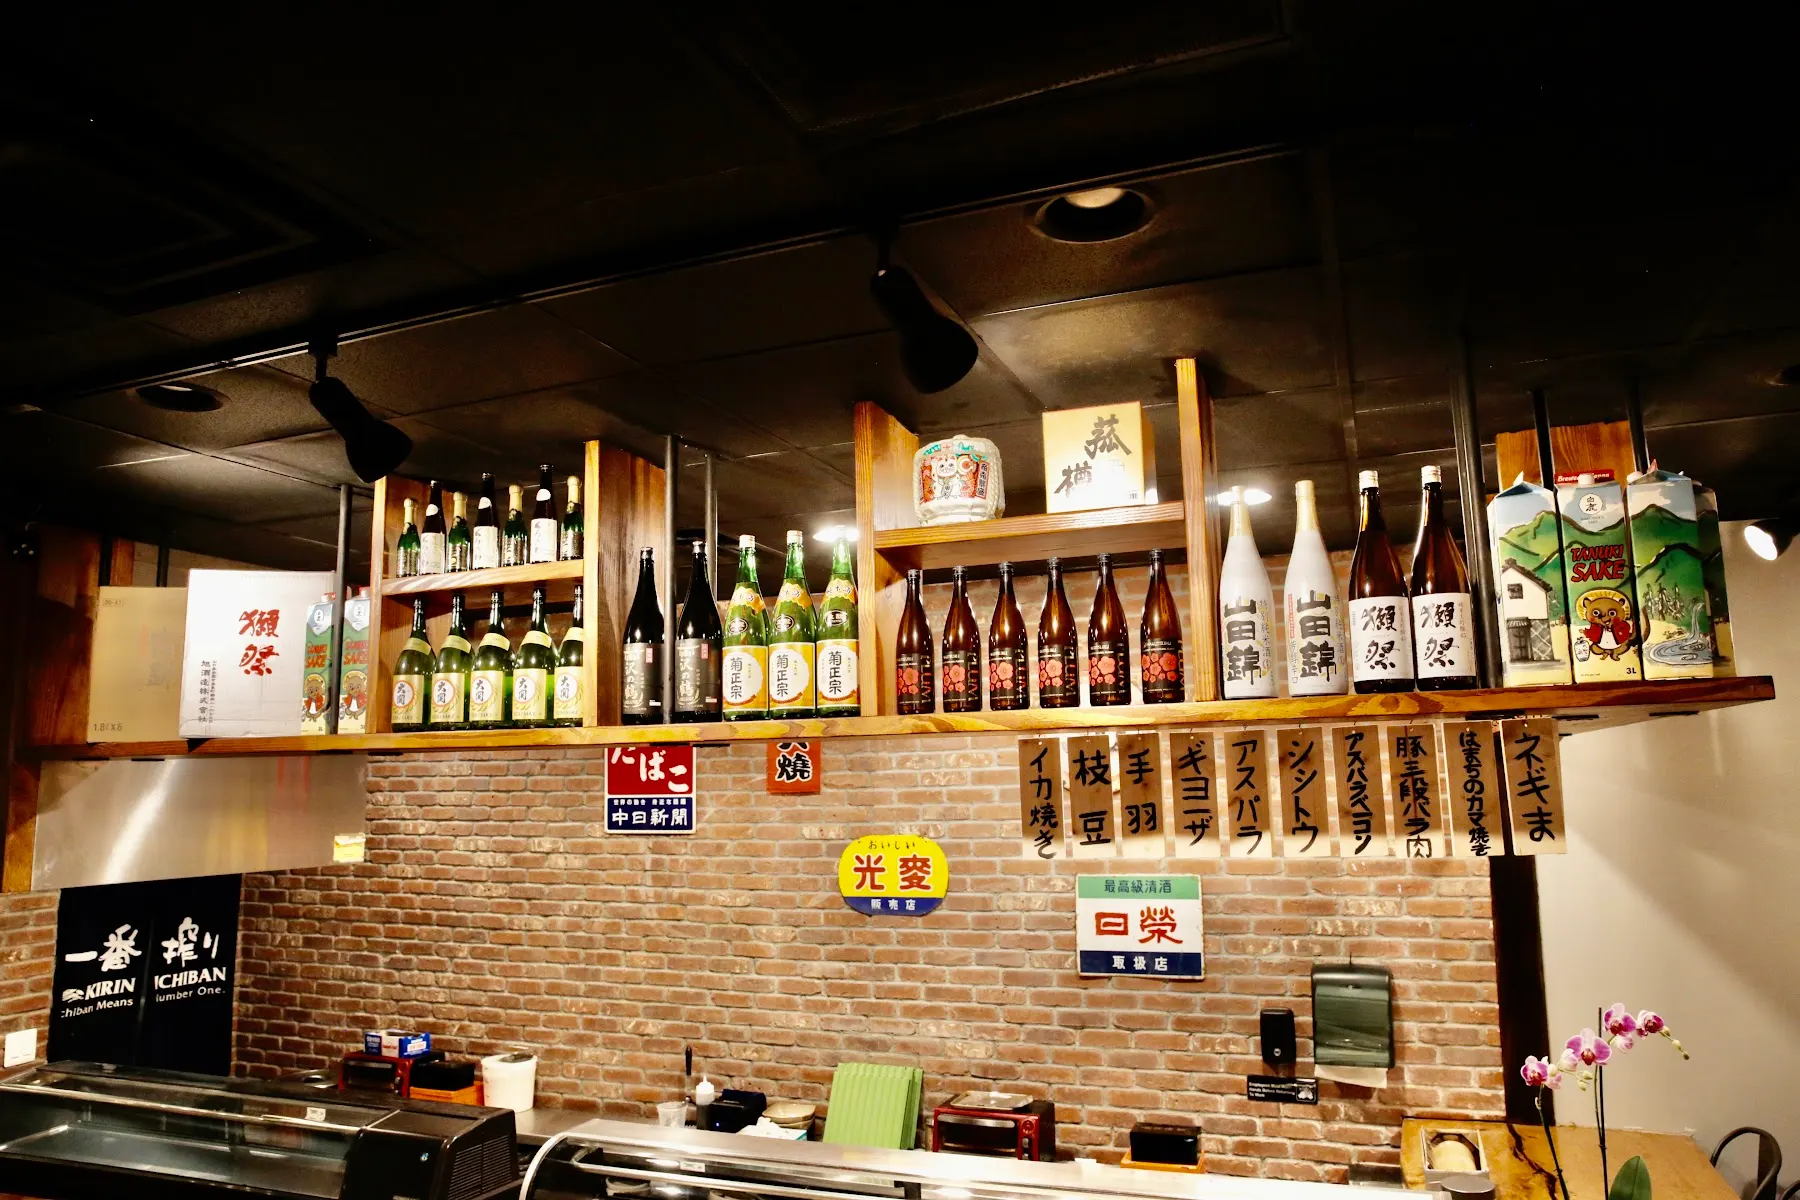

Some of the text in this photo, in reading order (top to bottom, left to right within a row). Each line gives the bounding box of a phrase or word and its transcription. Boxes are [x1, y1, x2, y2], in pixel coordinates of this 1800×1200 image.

[1571, 544, 1624, 562] TANUKI
[1571, 559, 1625, 582] SAKE
[239, 609, 280, 676] 獺祭
[1224, 596, 1261, 685] 山田錦
[1297, 590, 1337, 682] 山田錦
[1361, 605, 1400, 670] 獺祭
[1420, 602, 1459, 667] 獺祭
[730, 657, 742, 700] 菊正宗
[777, 654, 788, 697] 菊正宗
[829, 651, 842, 695] 菊正宗
[1626, 667, 1637, 675] 3L
[1029, 747, 1058, 859] イカ焼き
[1072, 750, 1111, 845] 枝豆
[1125, 748, 1157, 834] 手羽
[1232, 739, 1263, 855] アスパラ
[1288, 740, 1319, 853] シシトウ
[1396, 735, 1432, 858] 豚三段バラ肉
[1459, 731, 1491, 857] はまちのカマ焼き
[1514, 732, 1555, 842] ネギま
[611, 808, 688, 826] 中日新聞
[869, 841, 915, 850] おいしい
[871, 899, 915, 910] 販売店
[1104, 880, 1172, 894] 最高級清酒
[85, 967, 226, 1000] KIRIN ICHIBAN
[1112, 955, 1168, 971] 取扱店
[96, 999, 133, 1010] Means
[197, 986, 225, 996] One.
